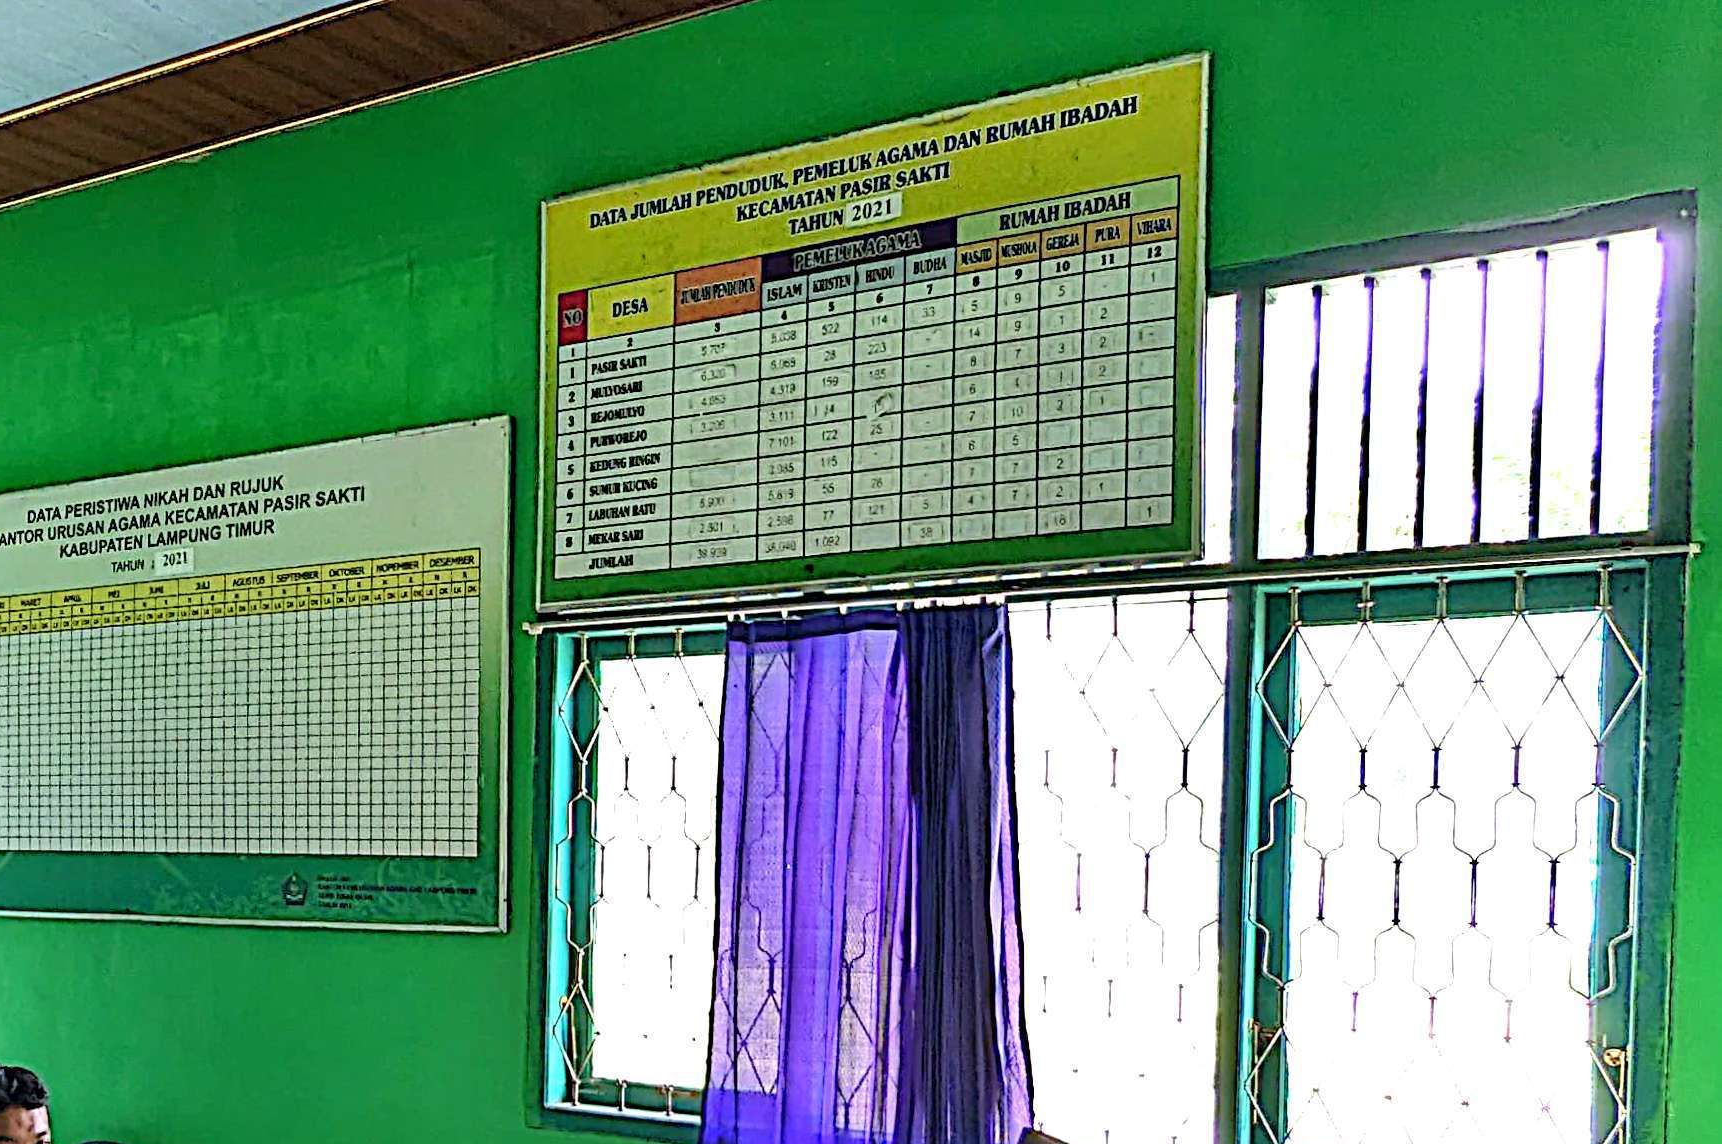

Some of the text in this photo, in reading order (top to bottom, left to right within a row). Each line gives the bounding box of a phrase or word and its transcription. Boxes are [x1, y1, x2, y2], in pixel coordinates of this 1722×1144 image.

[590, 96, 1138, 229] DATA JUMLAH PENDUDUK, PEMELUK AGAMA DAN RUMAH IBADAH
[736, 162, 950, 222] KECAMATAN PASIR SAKTI
[999, 192, 1131, 231] RUMAH IBADAH
[788, 198, 892, 235] TAHUN 2021
[794, 230, 922, 271] PEMELUK AGAMA
[961, 248, 992, 266] MASJID
[1046, 234, 1079, 250] GEREJA
[1095, 224, 1120, 243] PURA
[1137, 218, 1172, 235] VIHARA
[767, 256, 947, 301] ISLAM KRISTEN HINDU BUDHA
[781, 311, 787, 320] 4
[828, 301, 835, 311] 5
[876, 293, 883, 304] 6
[927, 285, 933, 294] 7
[972, 276, 980, 287] 8
[1015, 268, 1022, 280] 9
[1056, 261, 1070, 272] 10
[1101, 254, 1114, 266] 11
[1147, 246, 1162, 258] 12
[1014, 293, 1021, 304] 9
[1058, 285, 1065, 297] 5
[564, 310, 583, 325] NO
[612, 298, 648, 318] DESA
[568, 391, 576, 402] 2
[1014, 320, 1021, 332] 9
[1100, 308, 1108, 319] 2
[568, 416, 575, 427] 3
[1100, 336, 1107, 348] 2
[567, 440, 574, 451] 4
[567, 488, 574, 499] 6
[1012, 435, 1019, 446] 5
[566, 513, 573, 524] 7
[632, 503, 656, 517] RATU
[1056, 458, 1064, 470] 2
[568, 464, 574, 476] 5
[28, 474, 284, 524] DATA PERISTIWA NIKAH DAN RUJUK
[47, 520, 105, 541] URUSAN
[108, 512, 160, 533] AGAMA
[165, 499, 259, 526] KECAMATAN
[263, 493, 311, 514] PASIR
[315, 486, 365, 507] SAKTI
[566, 537, 572, 547] 8
[1056, 486, 1063, 497] 2
[59, 519, 275, 558] KABUPATEN LAMPUNG TIMUR
[111, 551, 188, 573] TAHUN 2021
[232, 576, 266, 587] AGUSTUS
[276, 570, 319, 582] SEPTEMBER
[329, 567, 364, 578] OKTOBER
[430, 555, 474, 568] DESEMBER
[589, 555, 633, 570] JUMLAH
